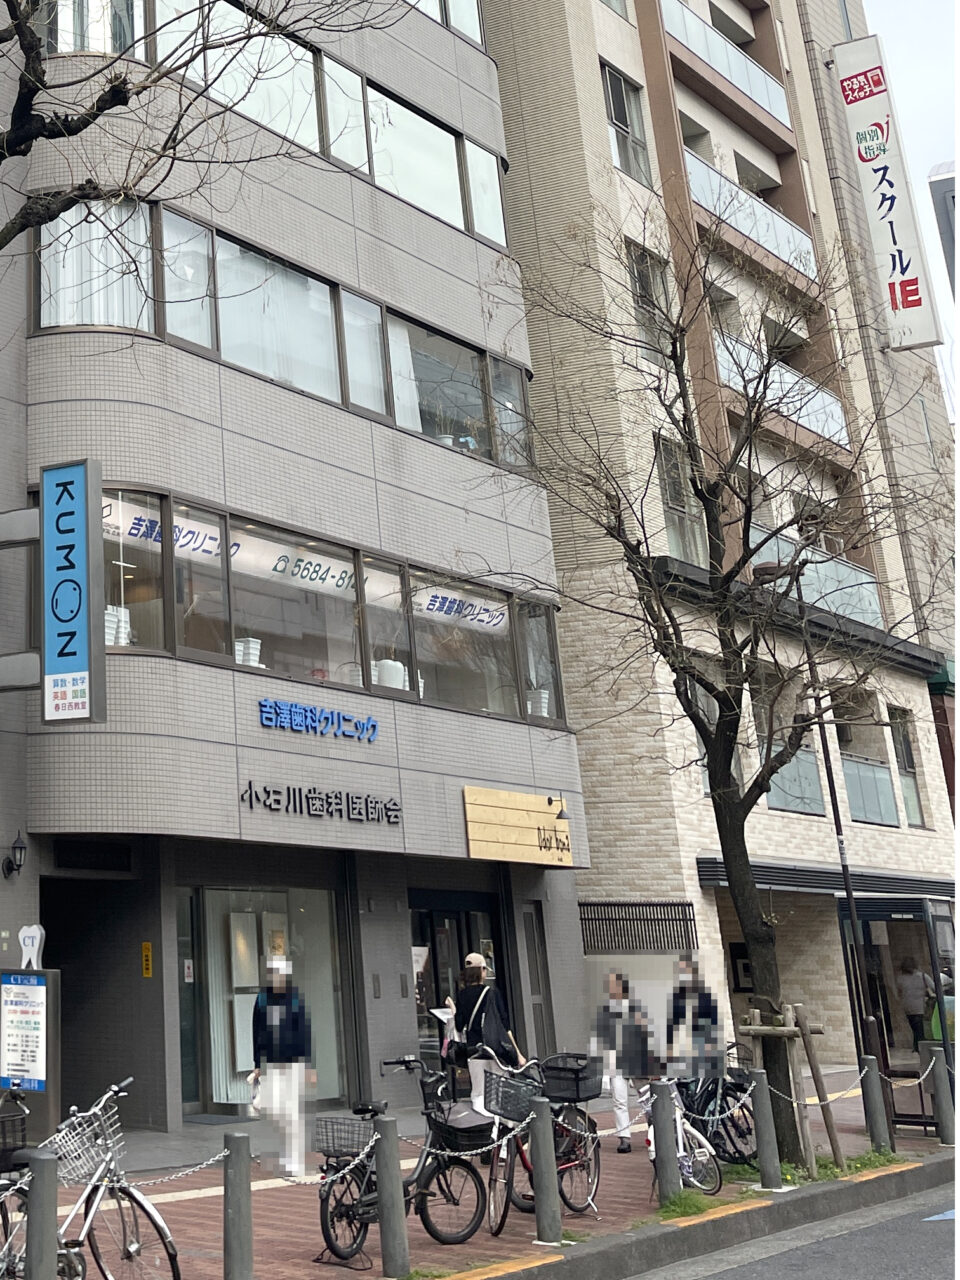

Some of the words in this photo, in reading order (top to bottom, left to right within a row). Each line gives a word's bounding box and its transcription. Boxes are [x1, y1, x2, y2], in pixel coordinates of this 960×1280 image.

[842, 75, 869, 93] やる気
[845, 85, 872, 104] スイッチ
[856, 128, 879, 146] 個別
[863, 143, 888, 159] 指導
[51, 480, 82, 658] KUMON
[258, 698, 379, 743] 吉澤歯科クリニック
[241, 780, 402, 825] 小石川歯科医師会
[22, 935, 37, 948] CT
